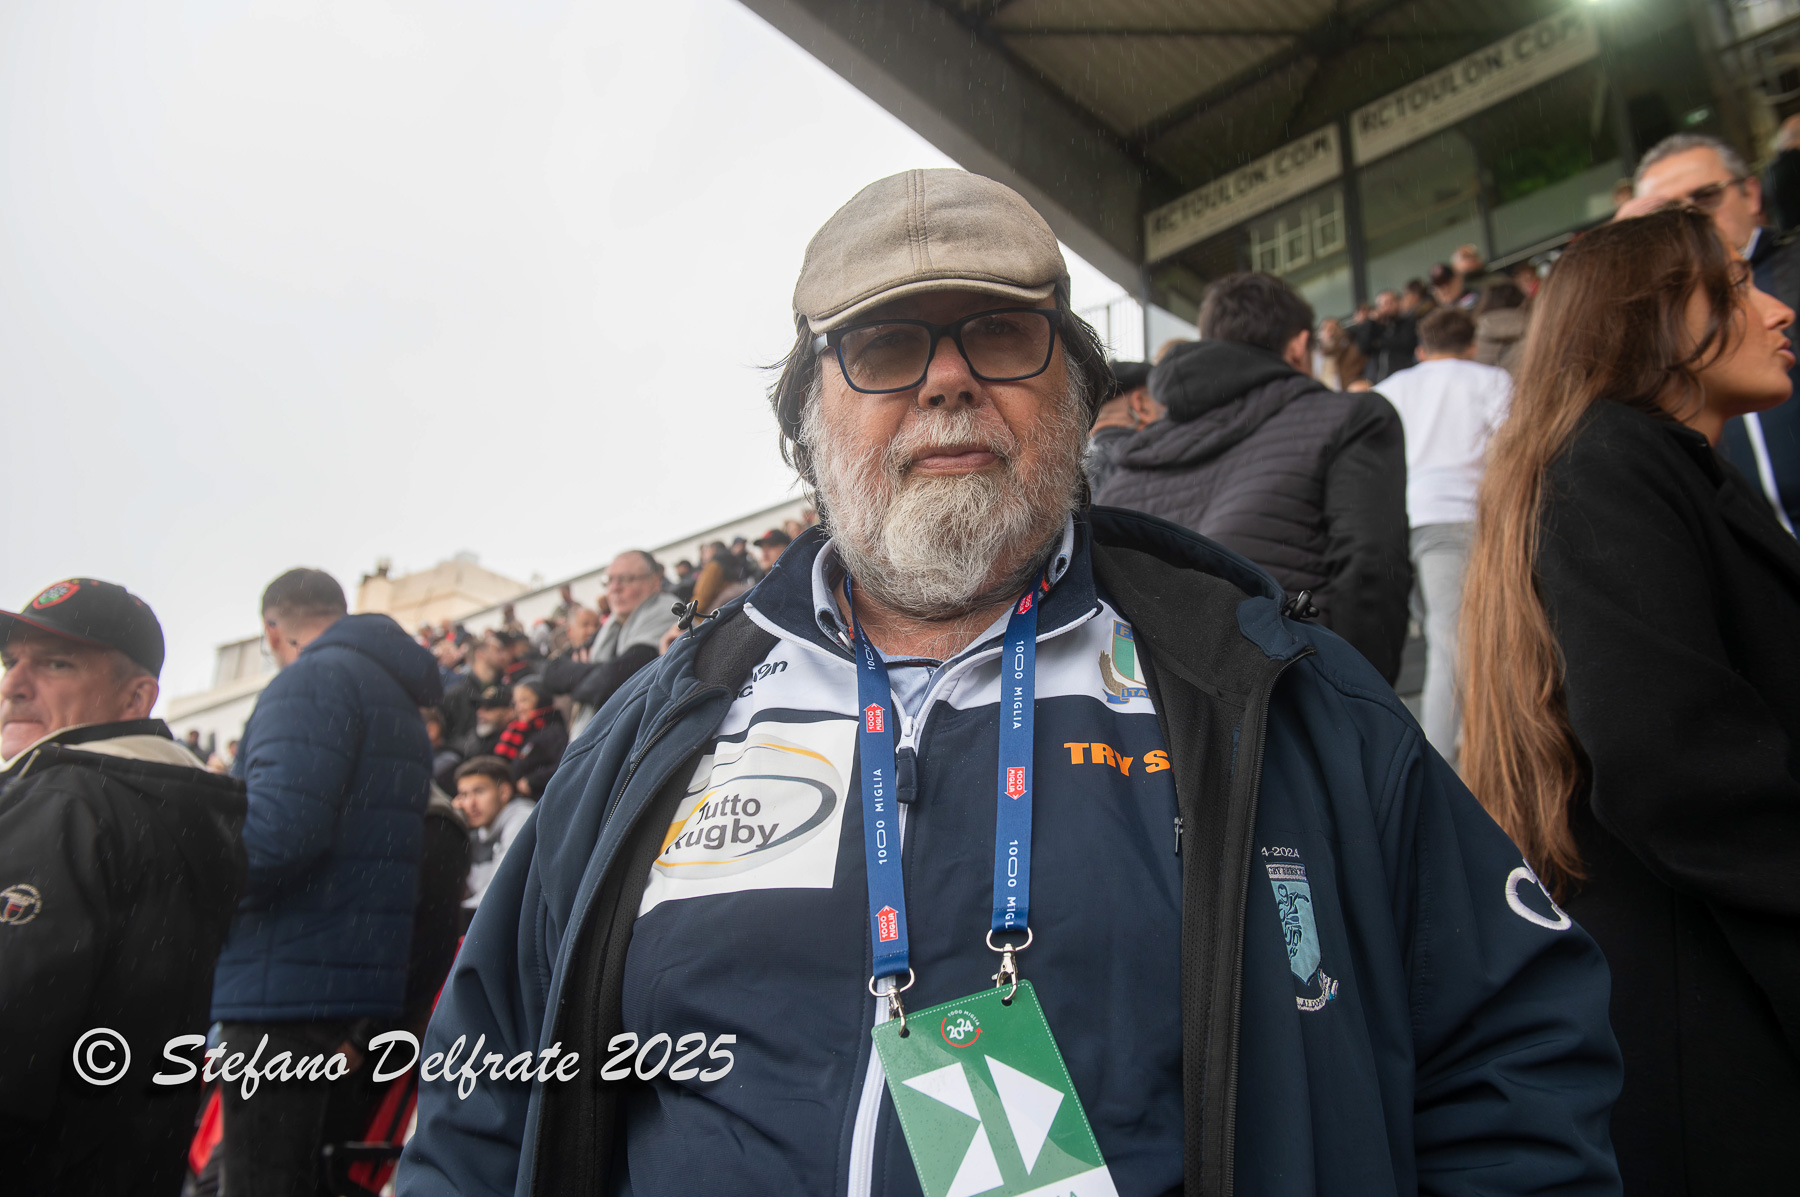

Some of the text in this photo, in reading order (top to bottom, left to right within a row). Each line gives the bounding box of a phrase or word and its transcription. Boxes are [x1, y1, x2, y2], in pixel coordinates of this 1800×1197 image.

[1012, 687, 1023, 729] MIGLIA
[1063, 742, 1175, 777] TRY S
[873, 768, 884, 812] MIGLIA
[1261, 846, 1300, 858] 4-2024
[880, 912, 897, 938] 1000 MIGLIA
[1005, 896, 1017, 931] MIGL
[946, 1017, 974, 1040] 2024
